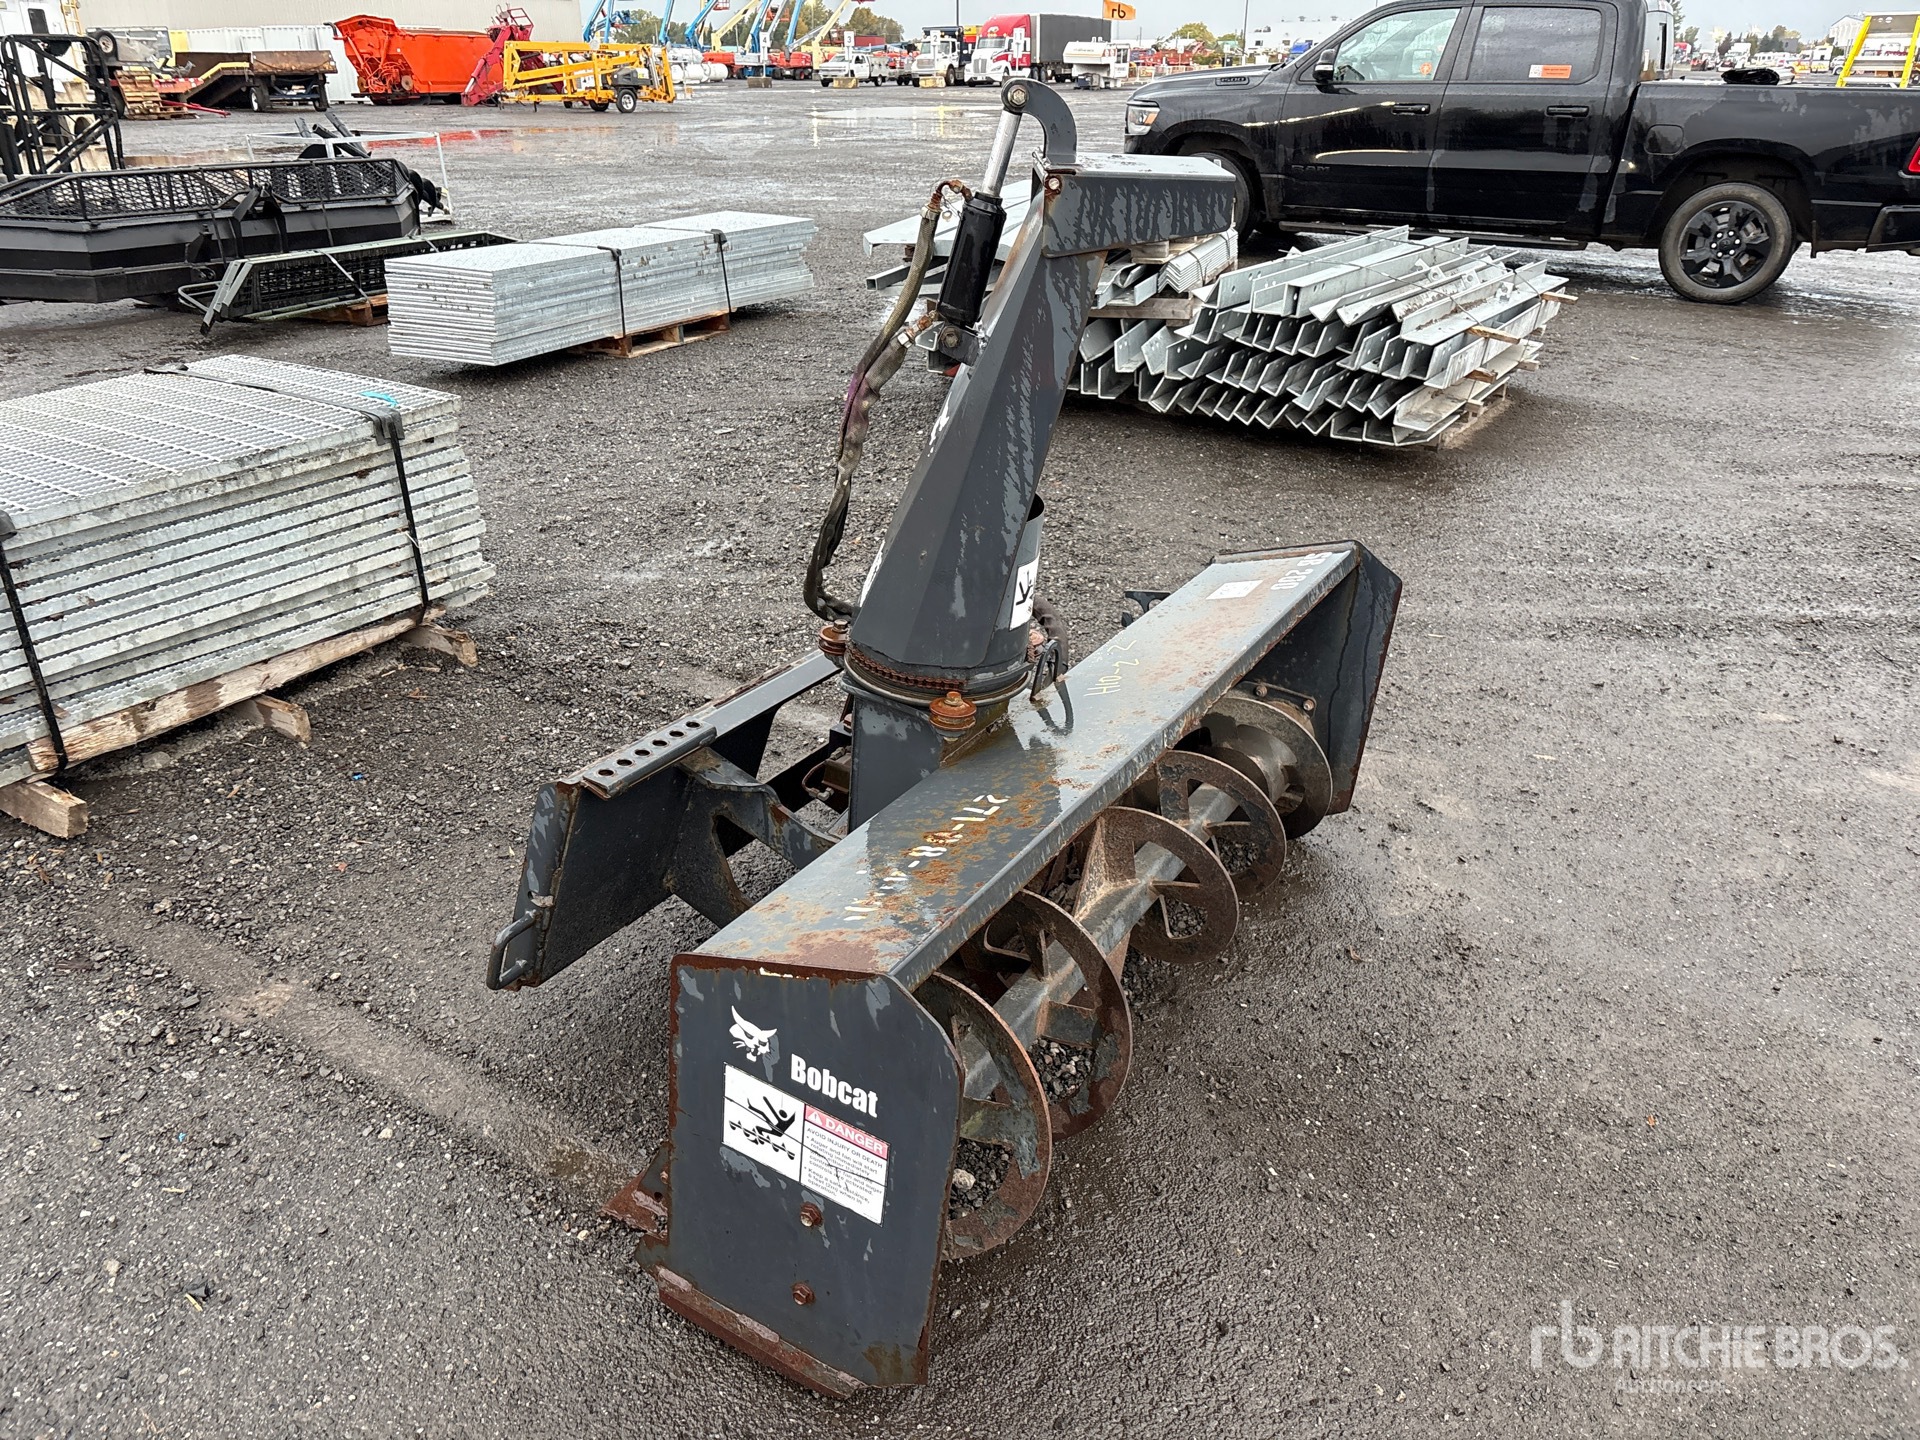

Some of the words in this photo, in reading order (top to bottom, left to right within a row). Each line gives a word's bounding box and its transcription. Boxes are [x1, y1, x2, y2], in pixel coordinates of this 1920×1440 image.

[1112, 4, 1126, 18] rb
[791, 1053, 879, 1119] Bobcat
[807, 1127, 826, 1140] AVOID
[827, 1137, 850, 1151] INJURY
[851, 1149, 861, 1158] OR
[861, 1155, 883, 1169] DEATH
[825, 1116, 883, 1156] DANGER
[808, 1168, 823, 1180] Keep
[810, 1137, 828, 1150] Auger
[863, 1164, 878, 1175] start
